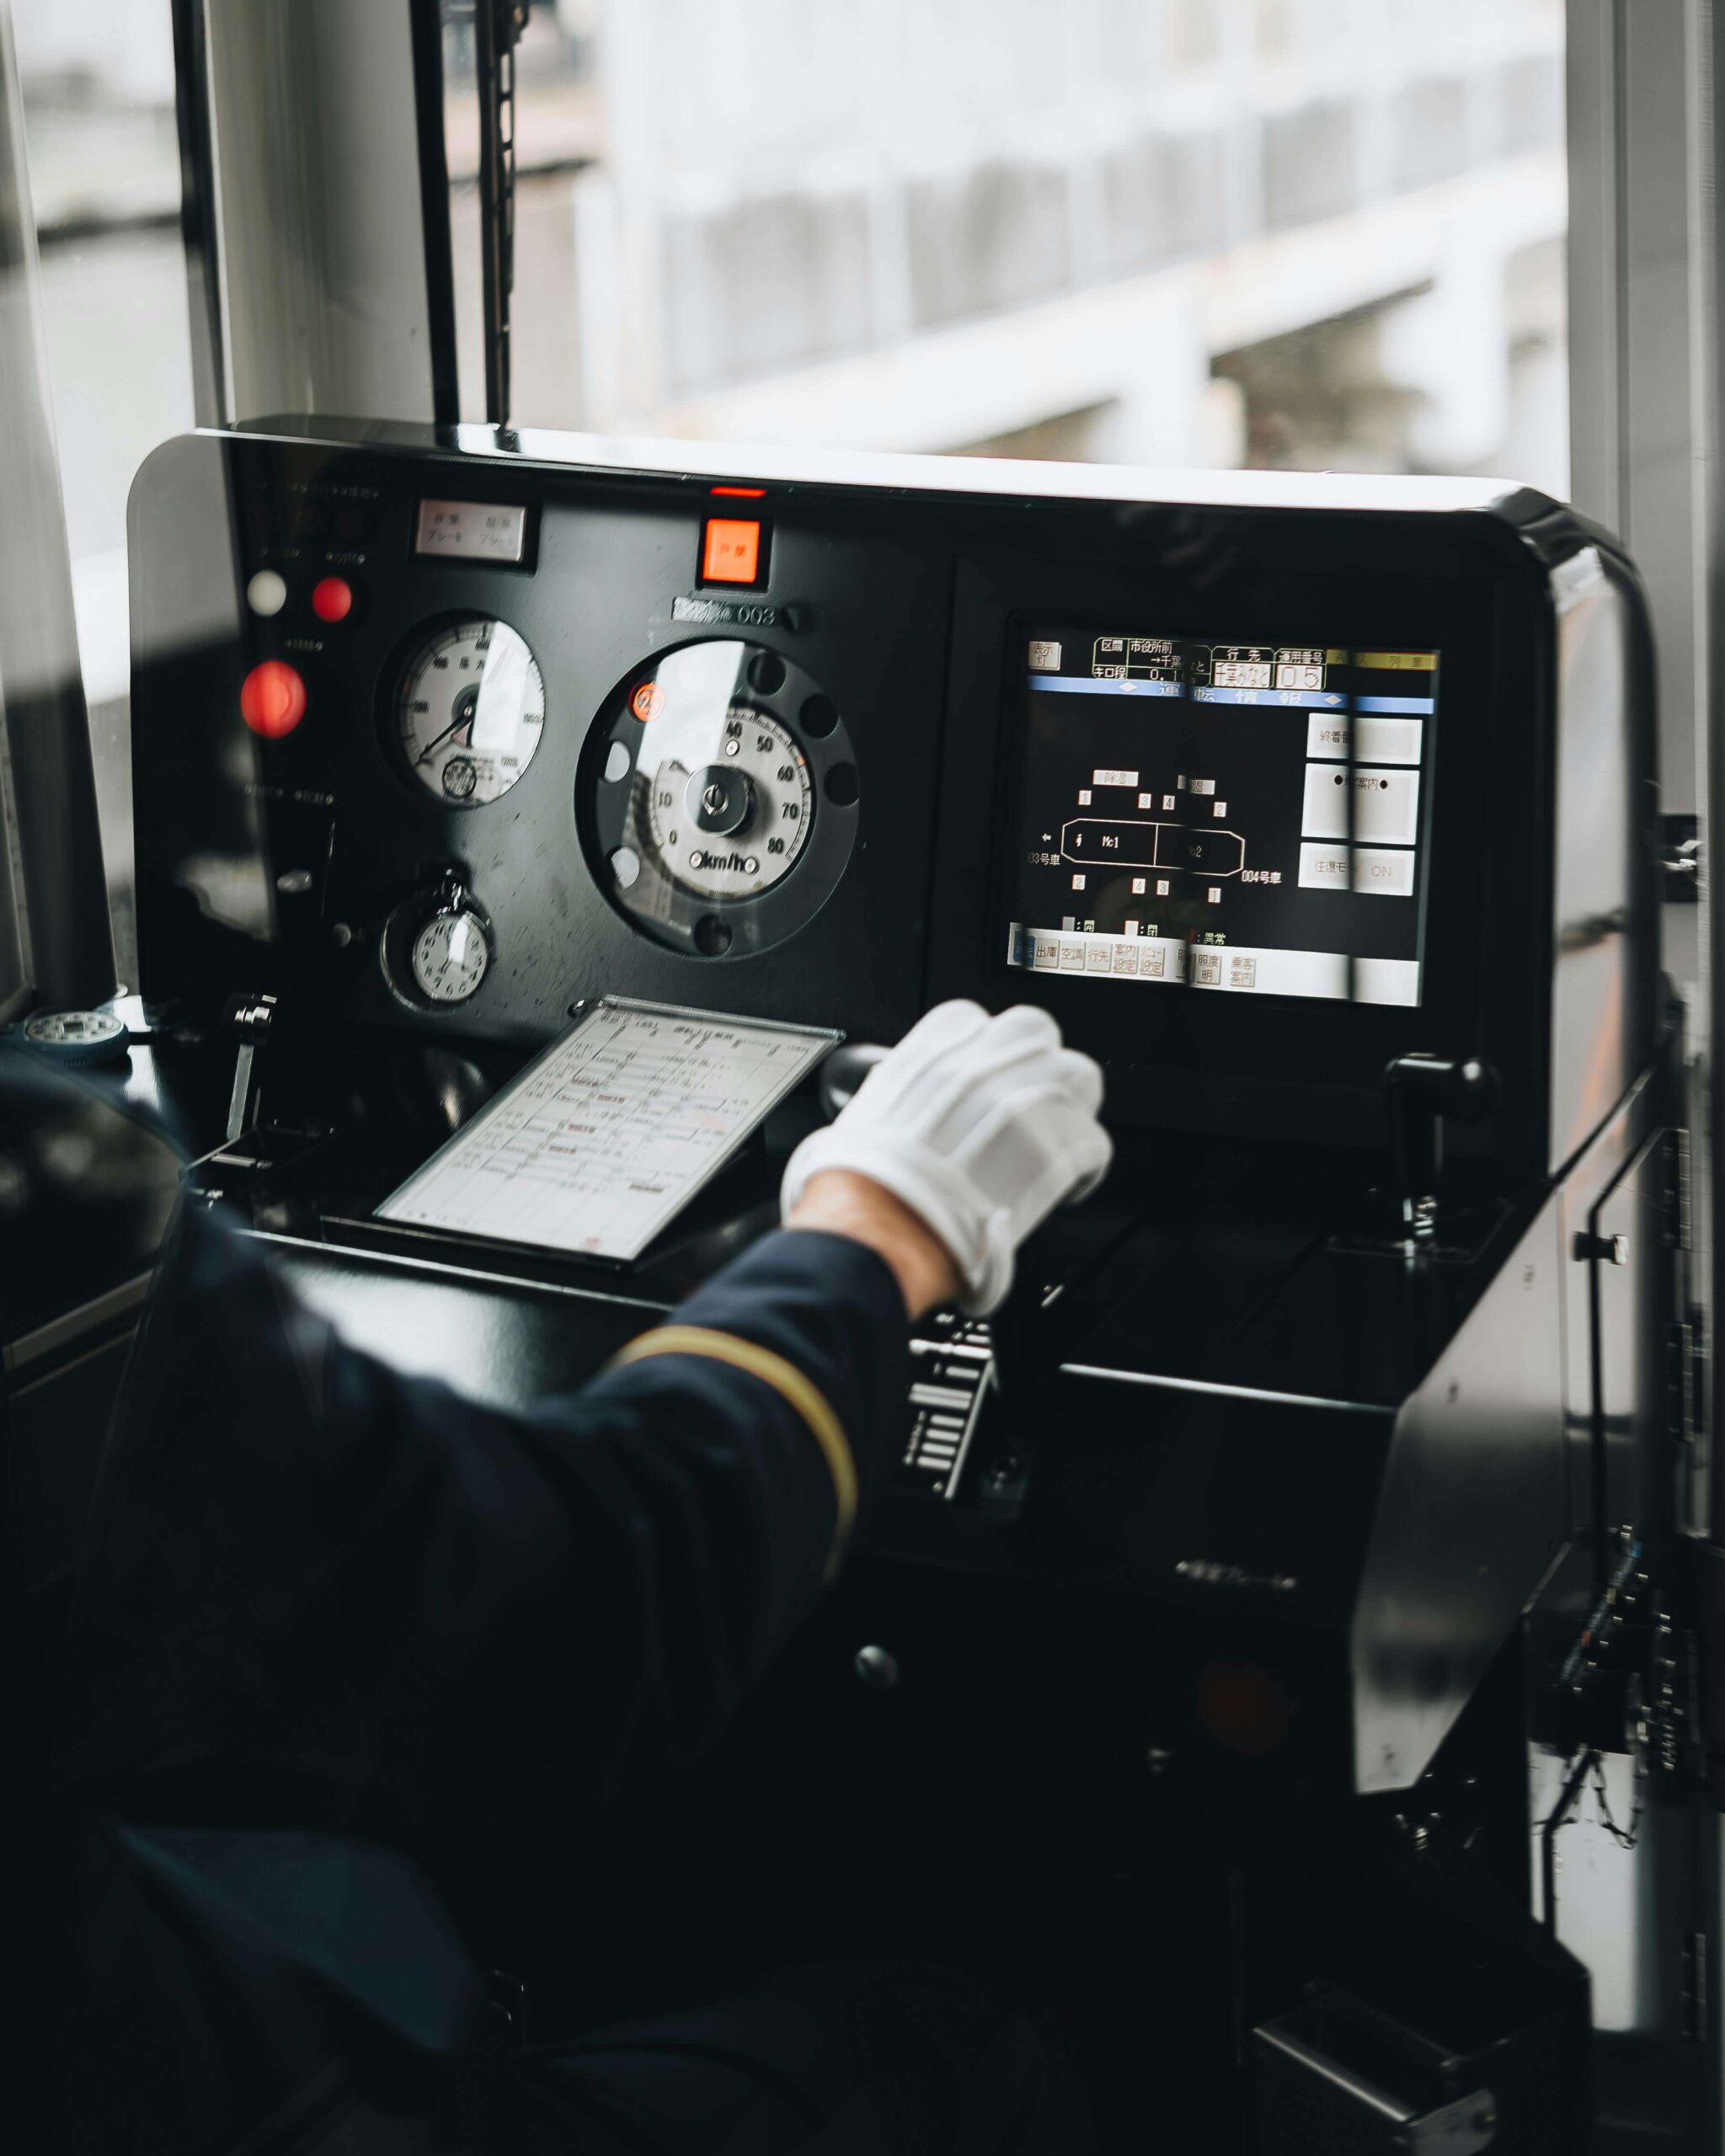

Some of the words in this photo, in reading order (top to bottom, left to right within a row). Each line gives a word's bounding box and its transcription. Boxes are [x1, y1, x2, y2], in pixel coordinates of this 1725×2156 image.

[1130, 640, 1172, 654] 市役所前
[1226, 648, 1262, 662] 行先
[1094, 665, 1128, 680] キロ程
[1280, 666, 1321, 689] 05
[725, 720, 743, 739] 40
[756, 734, 774, 753] 50
[777, 764, 794, 782] 60
[659, 791, 672, 808] 10
[782, 802, 798, 820] 70
[669, 830, 677, 845] 0
[767, 836, 784, 855] 80
[701, 851, 745, 873] km/h
[1370, 866, 1392, 878] ON
[1036, 940, 1057, 958] 出庫
[1060, 947, 1083, 960] 空調
[1087, 948, 1109, 963] 行先
[1114, 943, 1137, 956] 案内
[1113, 958, 1135, 973] 設定
[1140, 959, 1162, 974] 設定
[1202, 969, 1213, 982] 明
